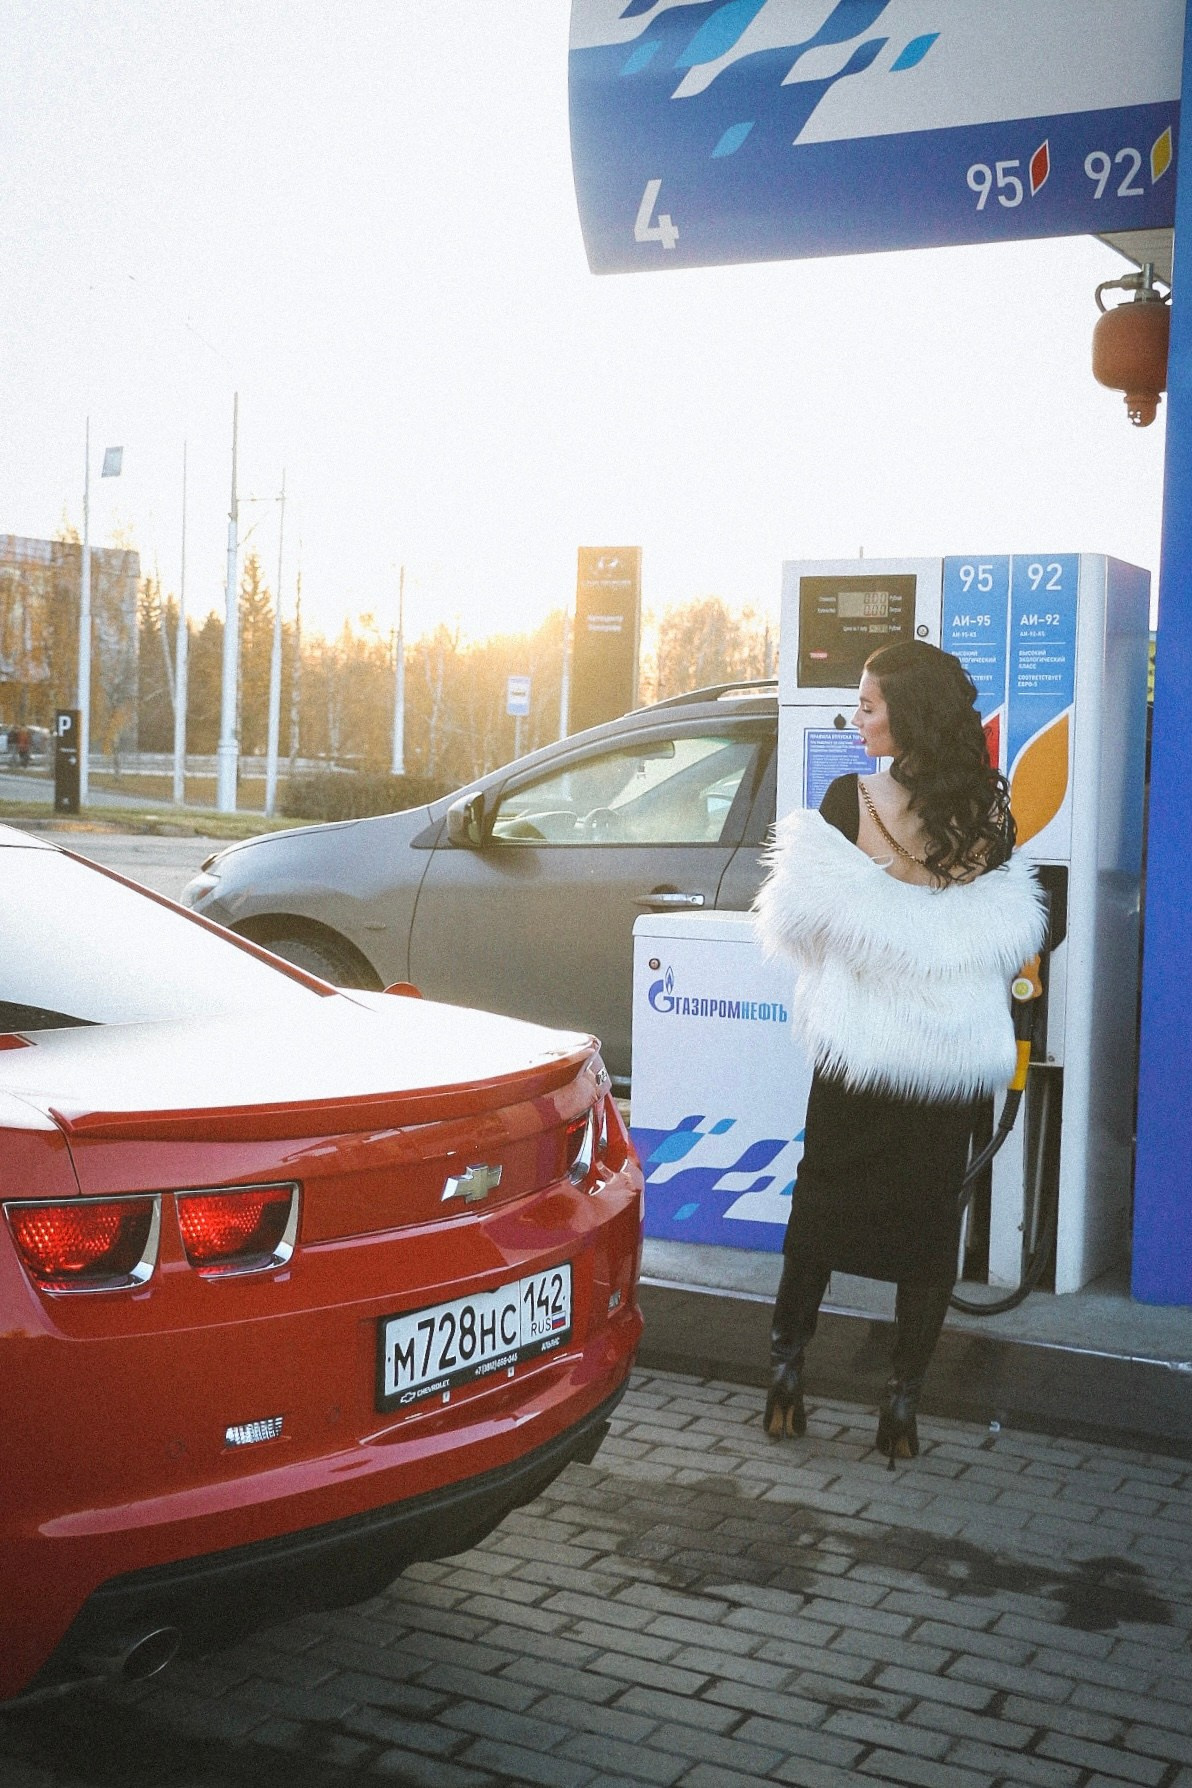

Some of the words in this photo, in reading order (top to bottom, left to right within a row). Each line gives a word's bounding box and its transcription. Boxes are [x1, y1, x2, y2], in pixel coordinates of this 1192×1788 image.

[966, 159, 1024, 210] 95
[1084, 148, 1144, 199] 92
[633, 179, 680, 249] 4
[959, 565, 993, 592] 95
[1028, 563, 1062, 591] 92
[952, 615, 991, 626] АИ-95
[1020, 614, 1060, 625] АИ-92
[58, 715, 72, 737] P
[675, 996, 788, 1023] ГАЗПРОМНЕФТЬ
[393, 1304, 517, 1387] М728НС
[523, 1273, 563, 1322] 142
[531, 1317, 552, 1337] RUS
[416, 1379, 451, 1397] CHEVROLET
